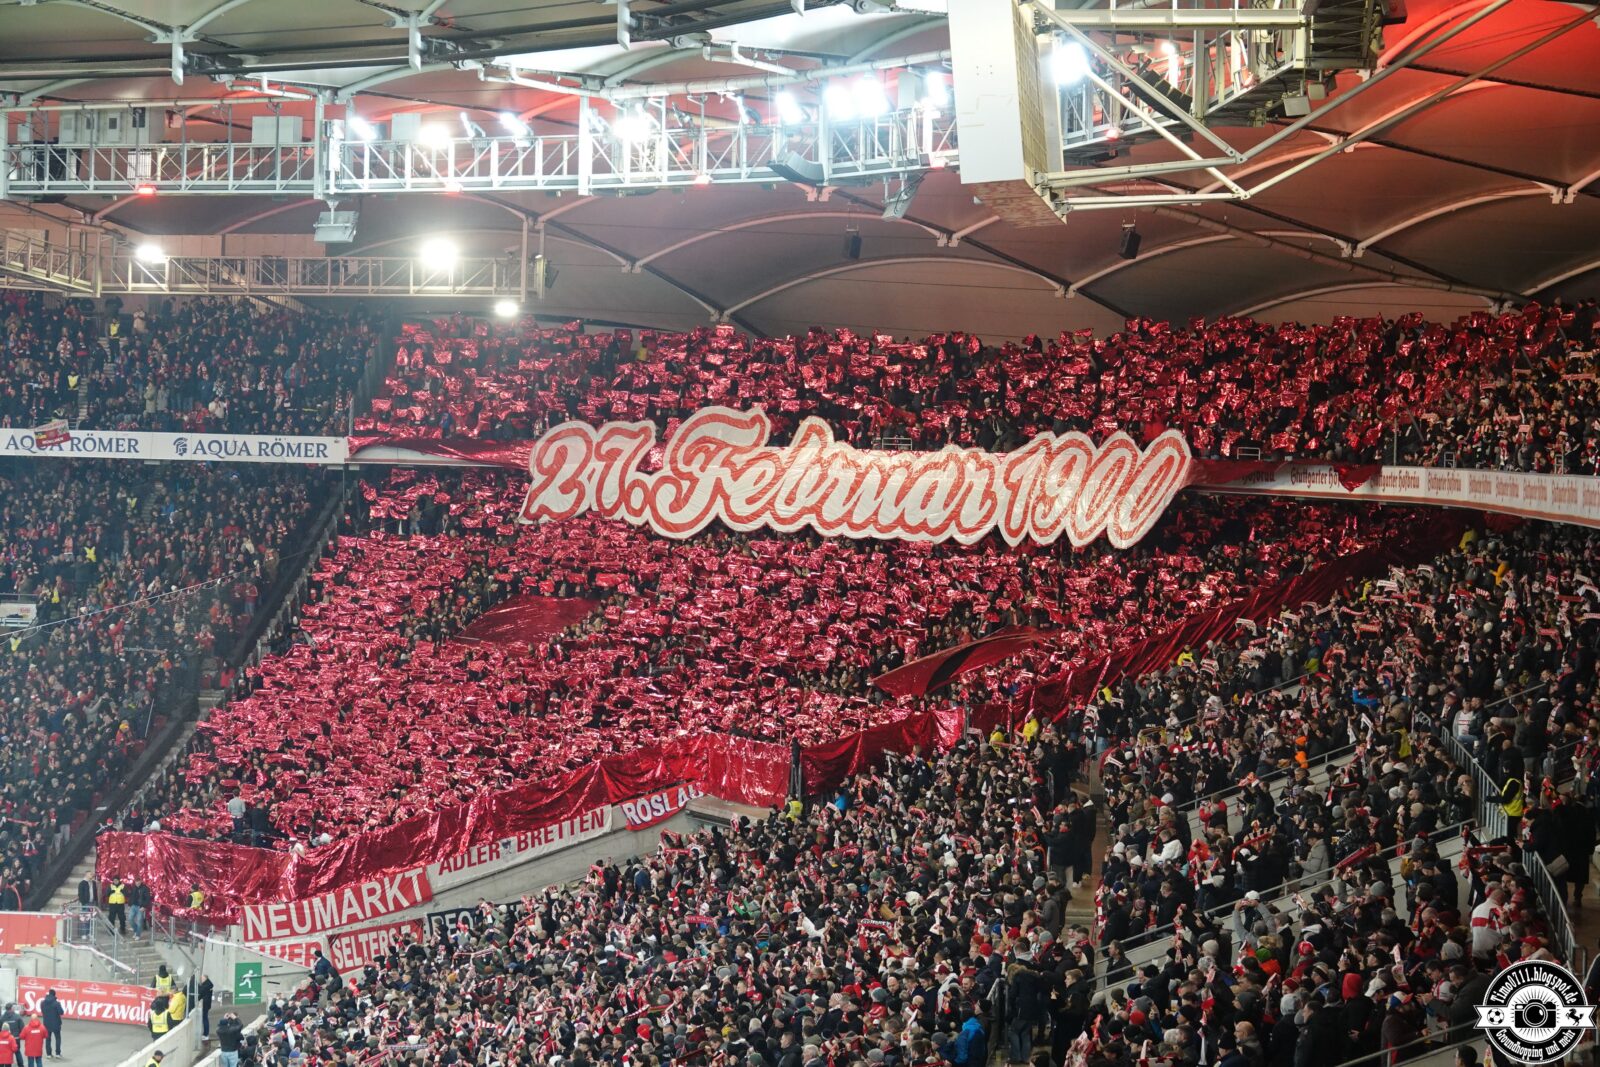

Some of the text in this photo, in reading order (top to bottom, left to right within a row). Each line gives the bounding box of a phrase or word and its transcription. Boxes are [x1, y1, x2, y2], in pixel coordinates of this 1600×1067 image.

[70, 432, 140, 453] RÖMER
[192, 437, 329, 459] AQUA RÖMER
[649, 411, 997, 534] Februar
[1003, 438, 1186, 541] 1900
[438, 808, 605, 875] ADLER BRETTEN
[244, 867, 423, 940] NEUMARKT
